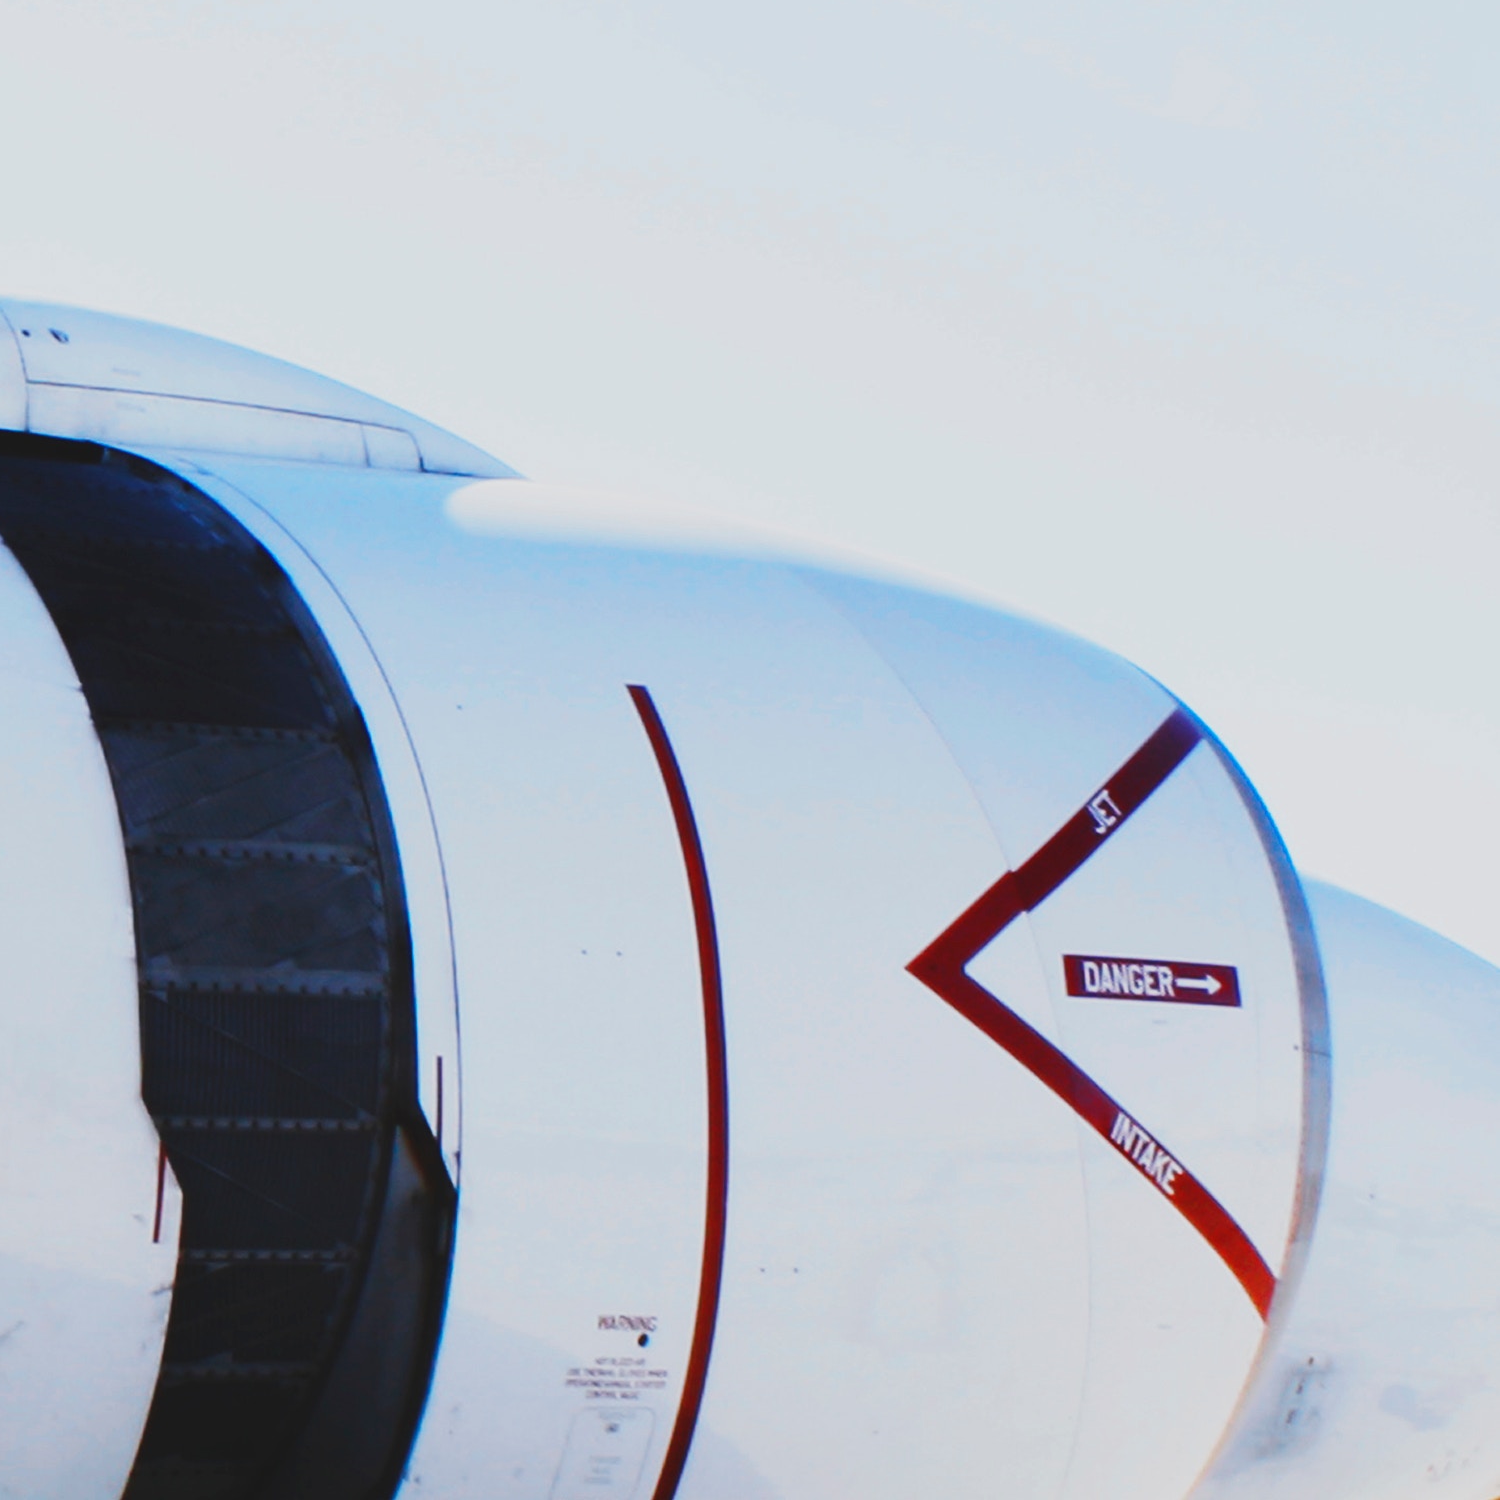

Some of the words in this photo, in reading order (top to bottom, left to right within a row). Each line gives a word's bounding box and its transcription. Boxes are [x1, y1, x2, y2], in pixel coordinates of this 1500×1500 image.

[1086, 789, 1122, 834] JET
[1082, 960, 1176, 997] DANGER
[1109, 1111, 1184, 1196] INTAKE
